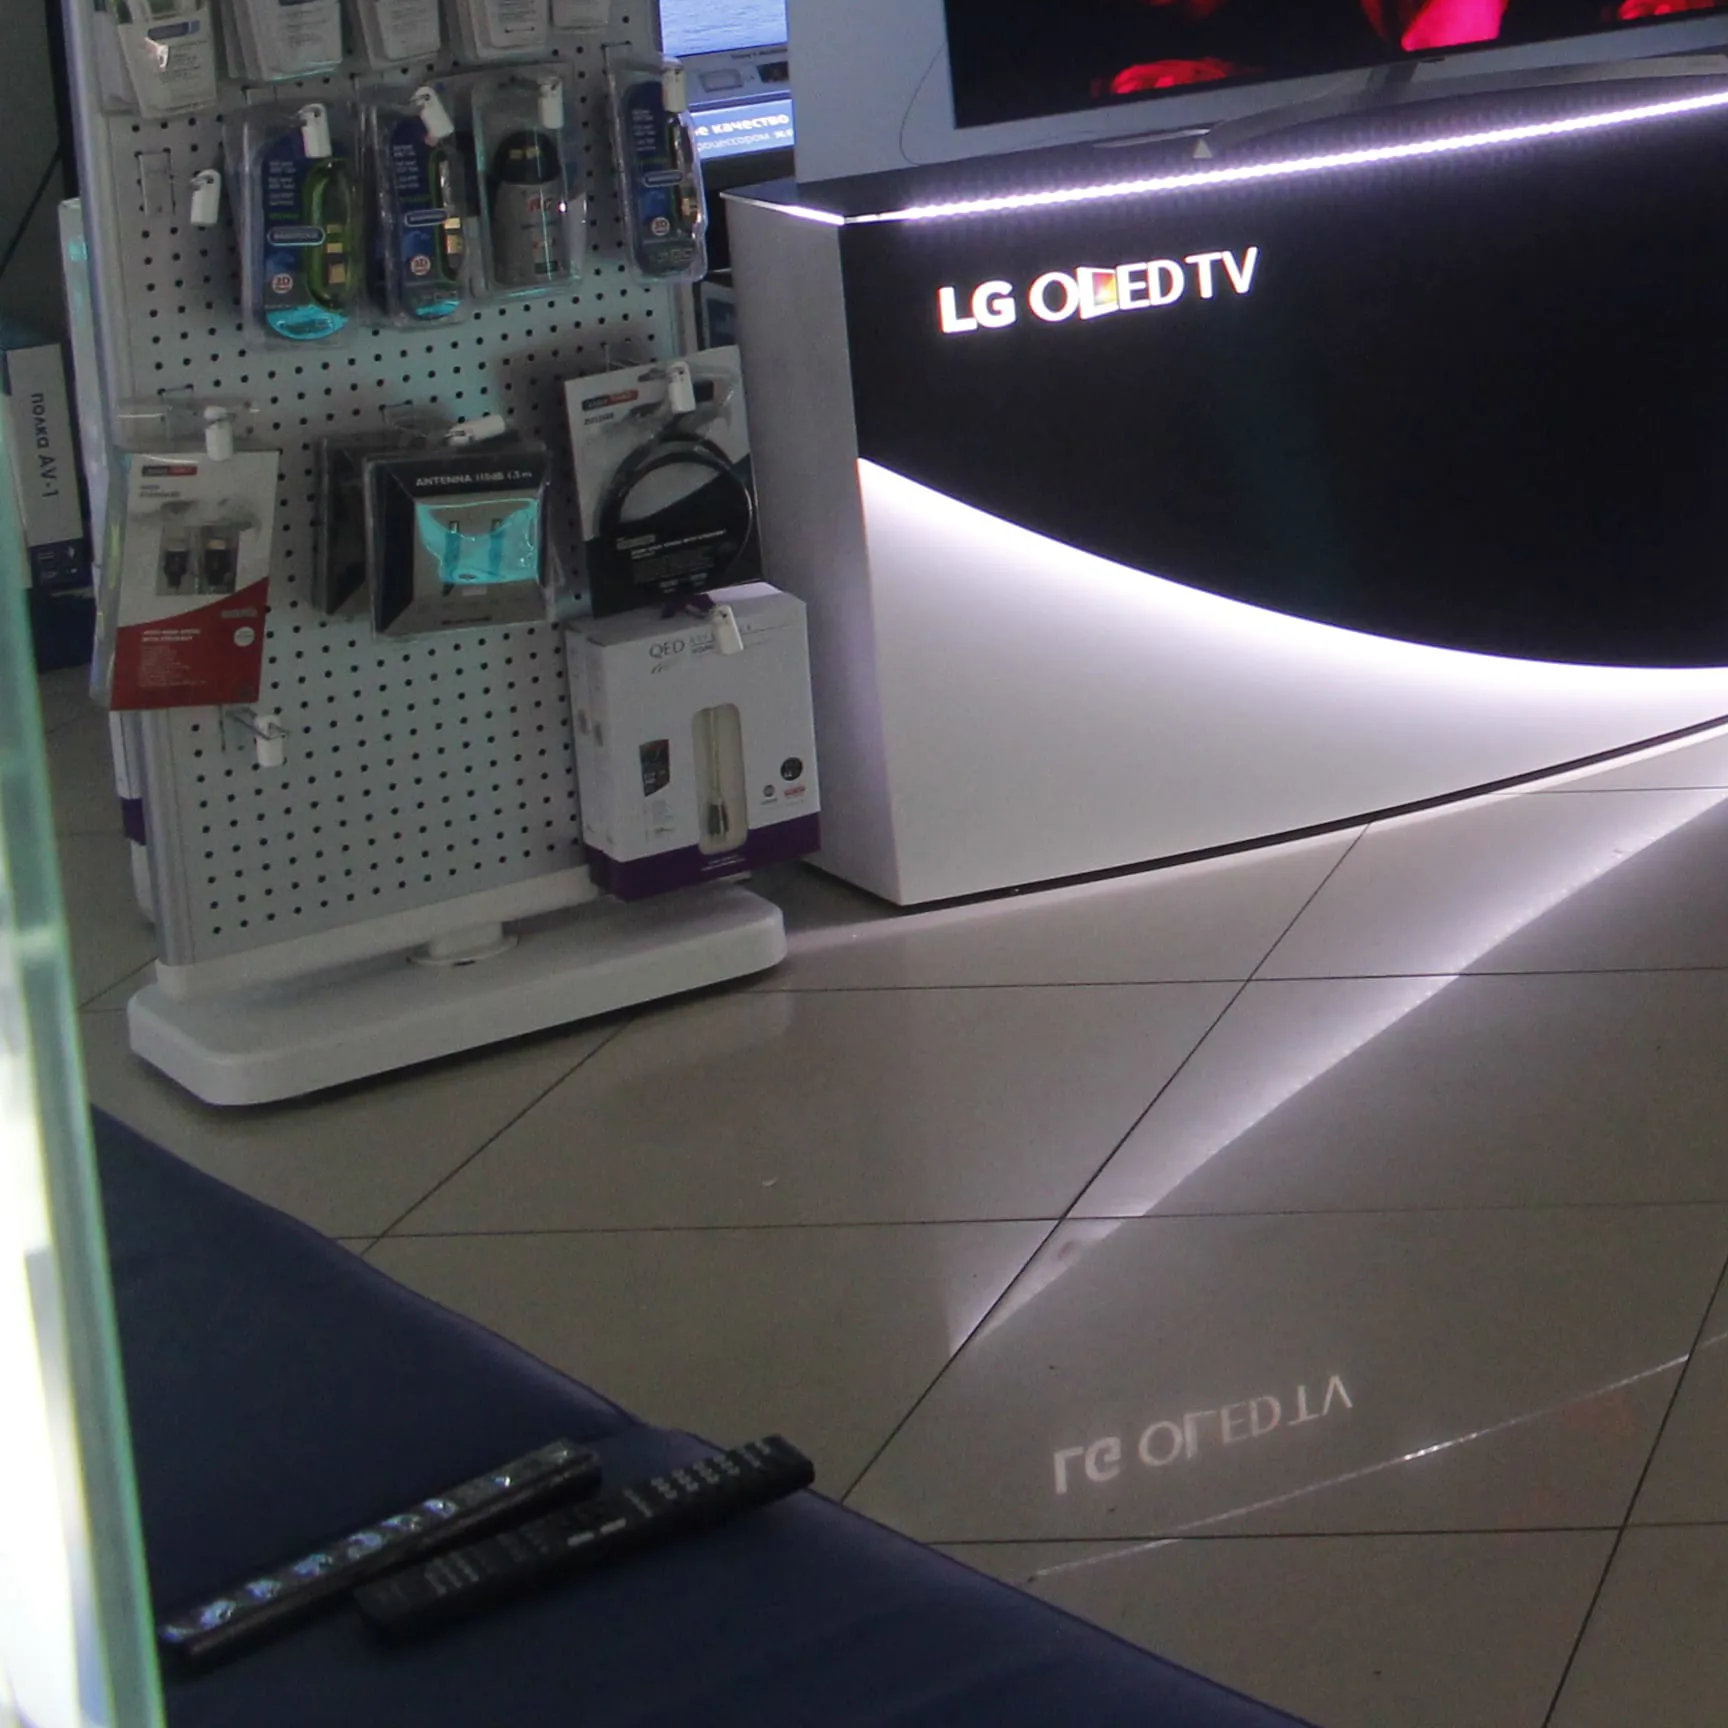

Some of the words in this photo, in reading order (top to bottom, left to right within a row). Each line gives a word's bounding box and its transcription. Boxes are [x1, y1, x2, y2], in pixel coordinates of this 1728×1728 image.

[711, 113, 790, 135] качество
[937, 281, 1017, 334] LG
[1029, 259, 1188, 321] OLED
[1188, 245, 1261, 300] TV
[31, 391, 49, 450] полка
[38, 453, 60, 499] AV-1
[415, 473, 473, 488] ANTENNA
[648, 639, 687, 660] QED
